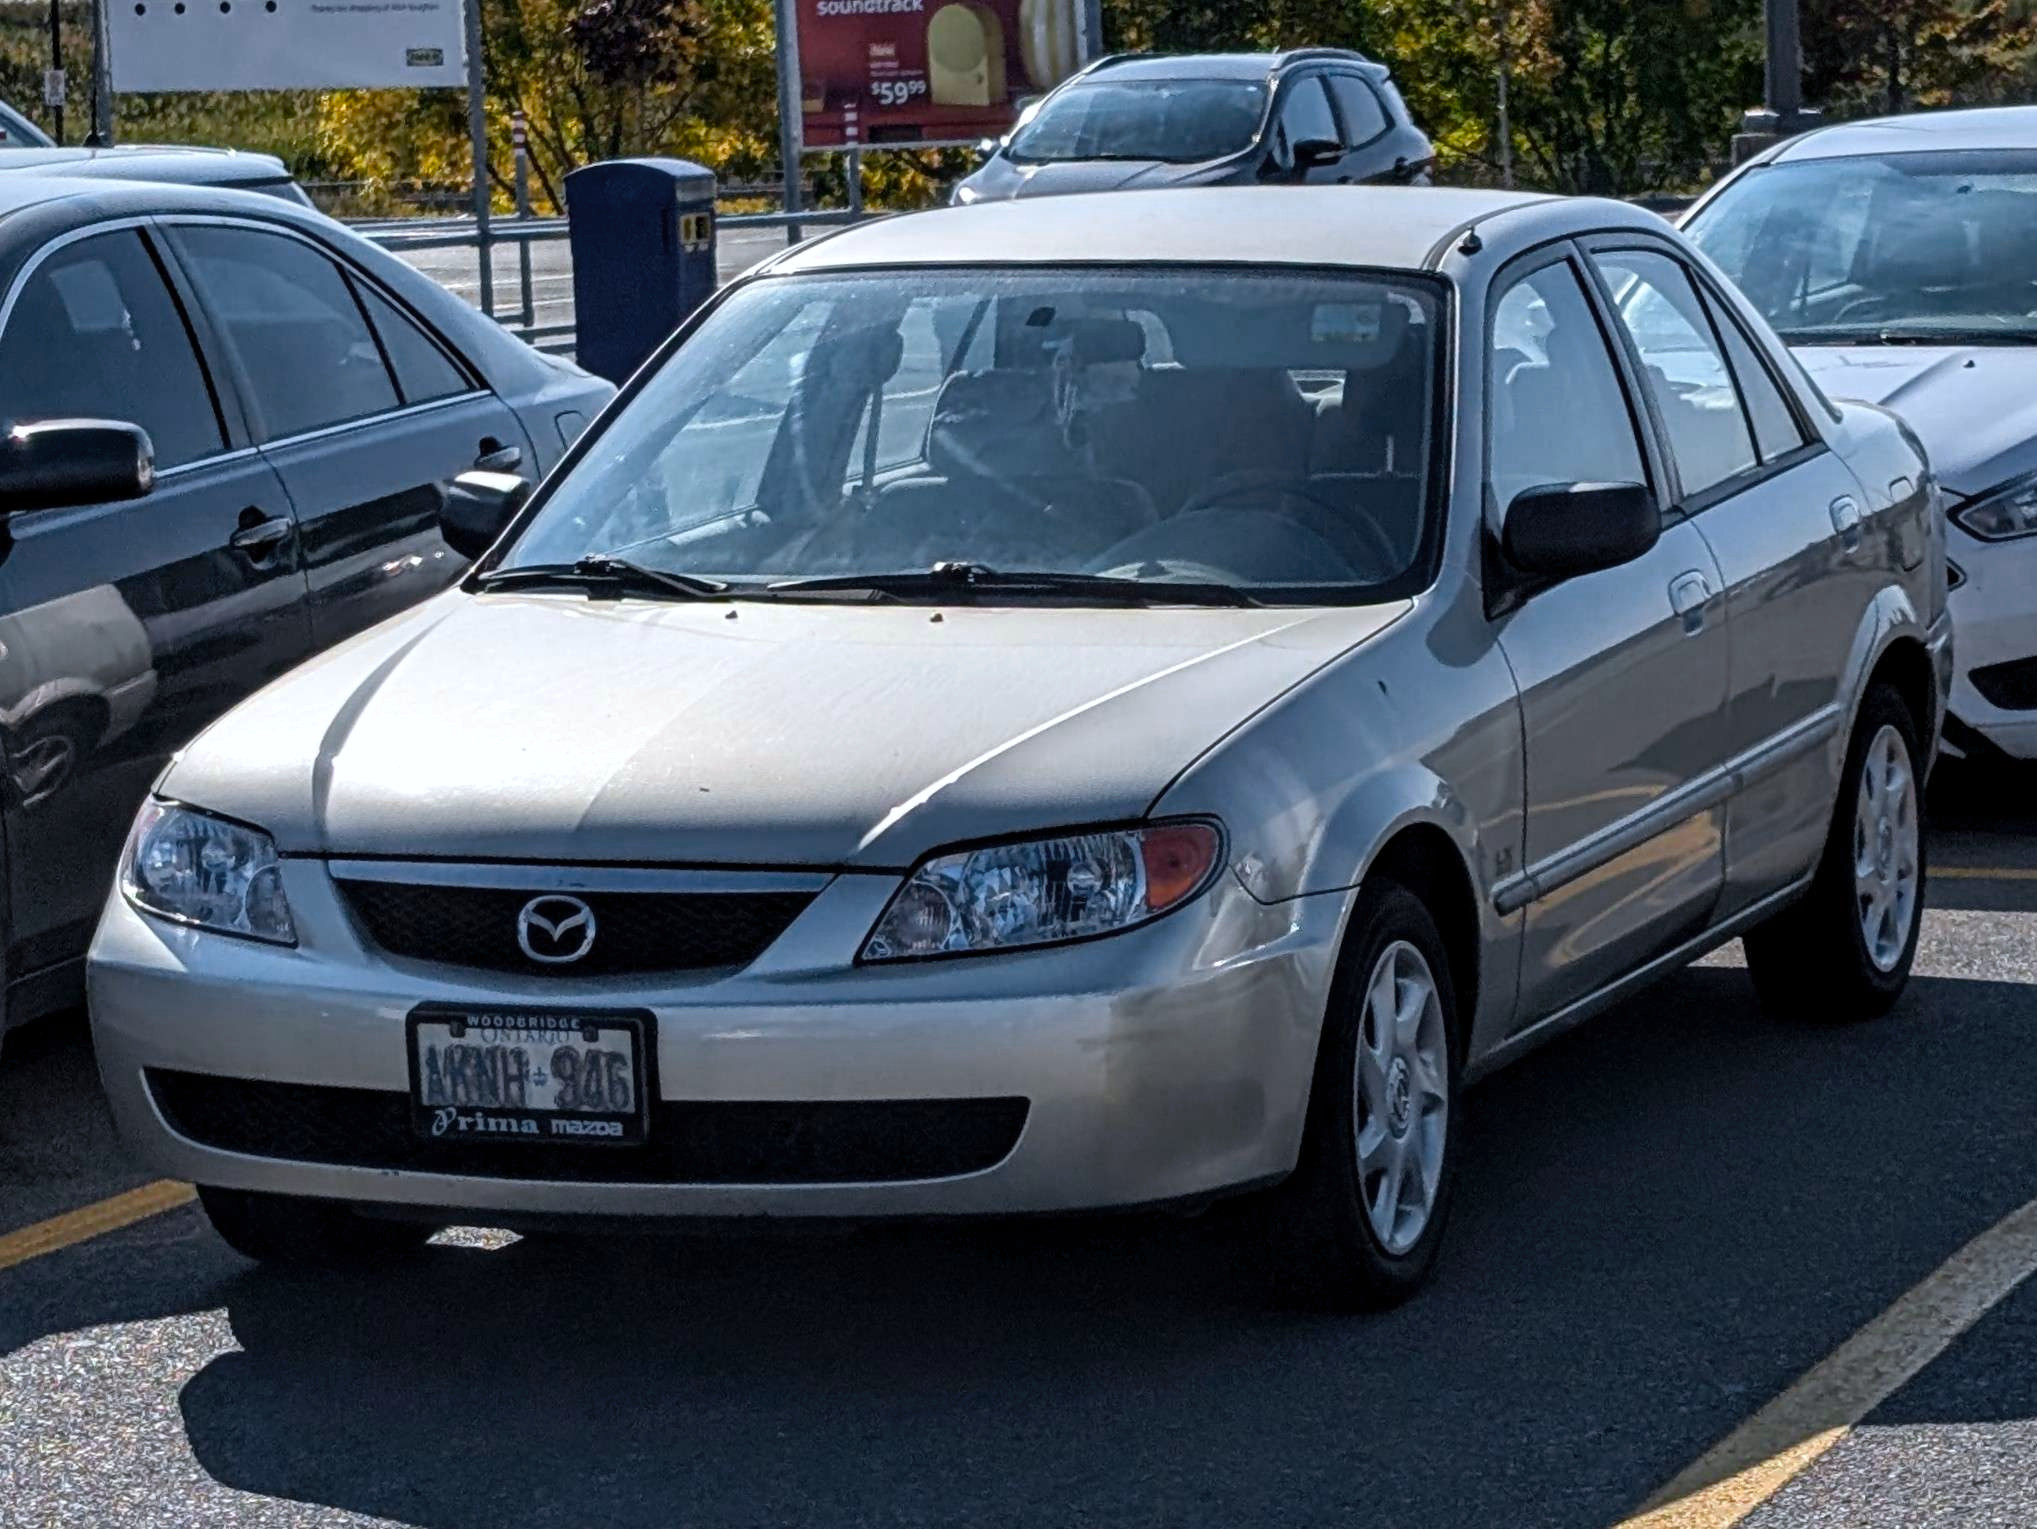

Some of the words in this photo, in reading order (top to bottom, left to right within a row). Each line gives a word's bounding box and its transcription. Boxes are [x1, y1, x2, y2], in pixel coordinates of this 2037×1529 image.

[816, 0, 924, 15] soundtrack
[467, 1015, 581, 1029] WOODBRIDGE
[480, 1029, 570, 1044] ONTARIO
[432, 1107, 540, 1136] Prima
[551, 1118, 624, 1137] mazda
